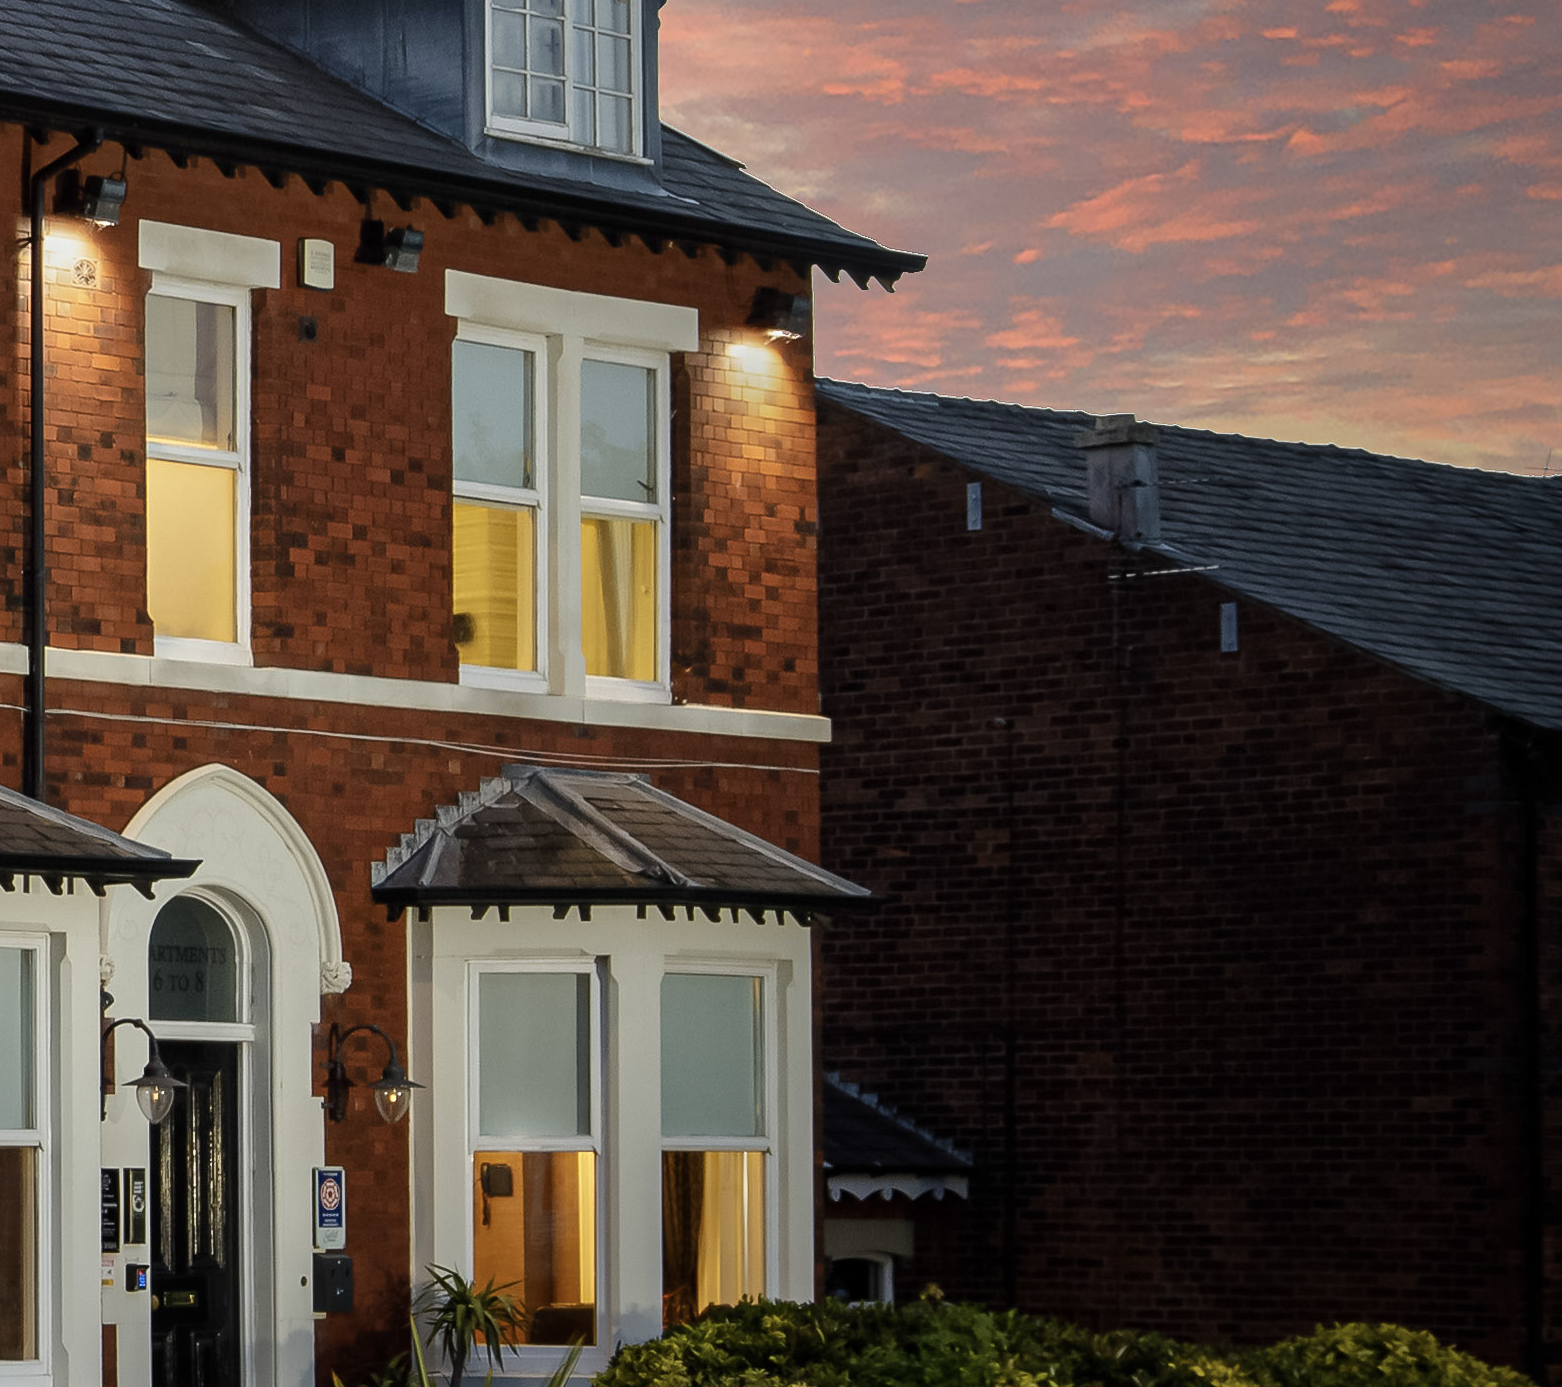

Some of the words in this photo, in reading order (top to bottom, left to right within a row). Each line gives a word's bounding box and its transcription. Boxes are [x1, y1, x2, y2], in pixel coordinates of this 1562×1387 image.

[153, 968, 163, 992] 6
[168, 974, 189, 992] TO
[195, 970, 205, 992] 8
